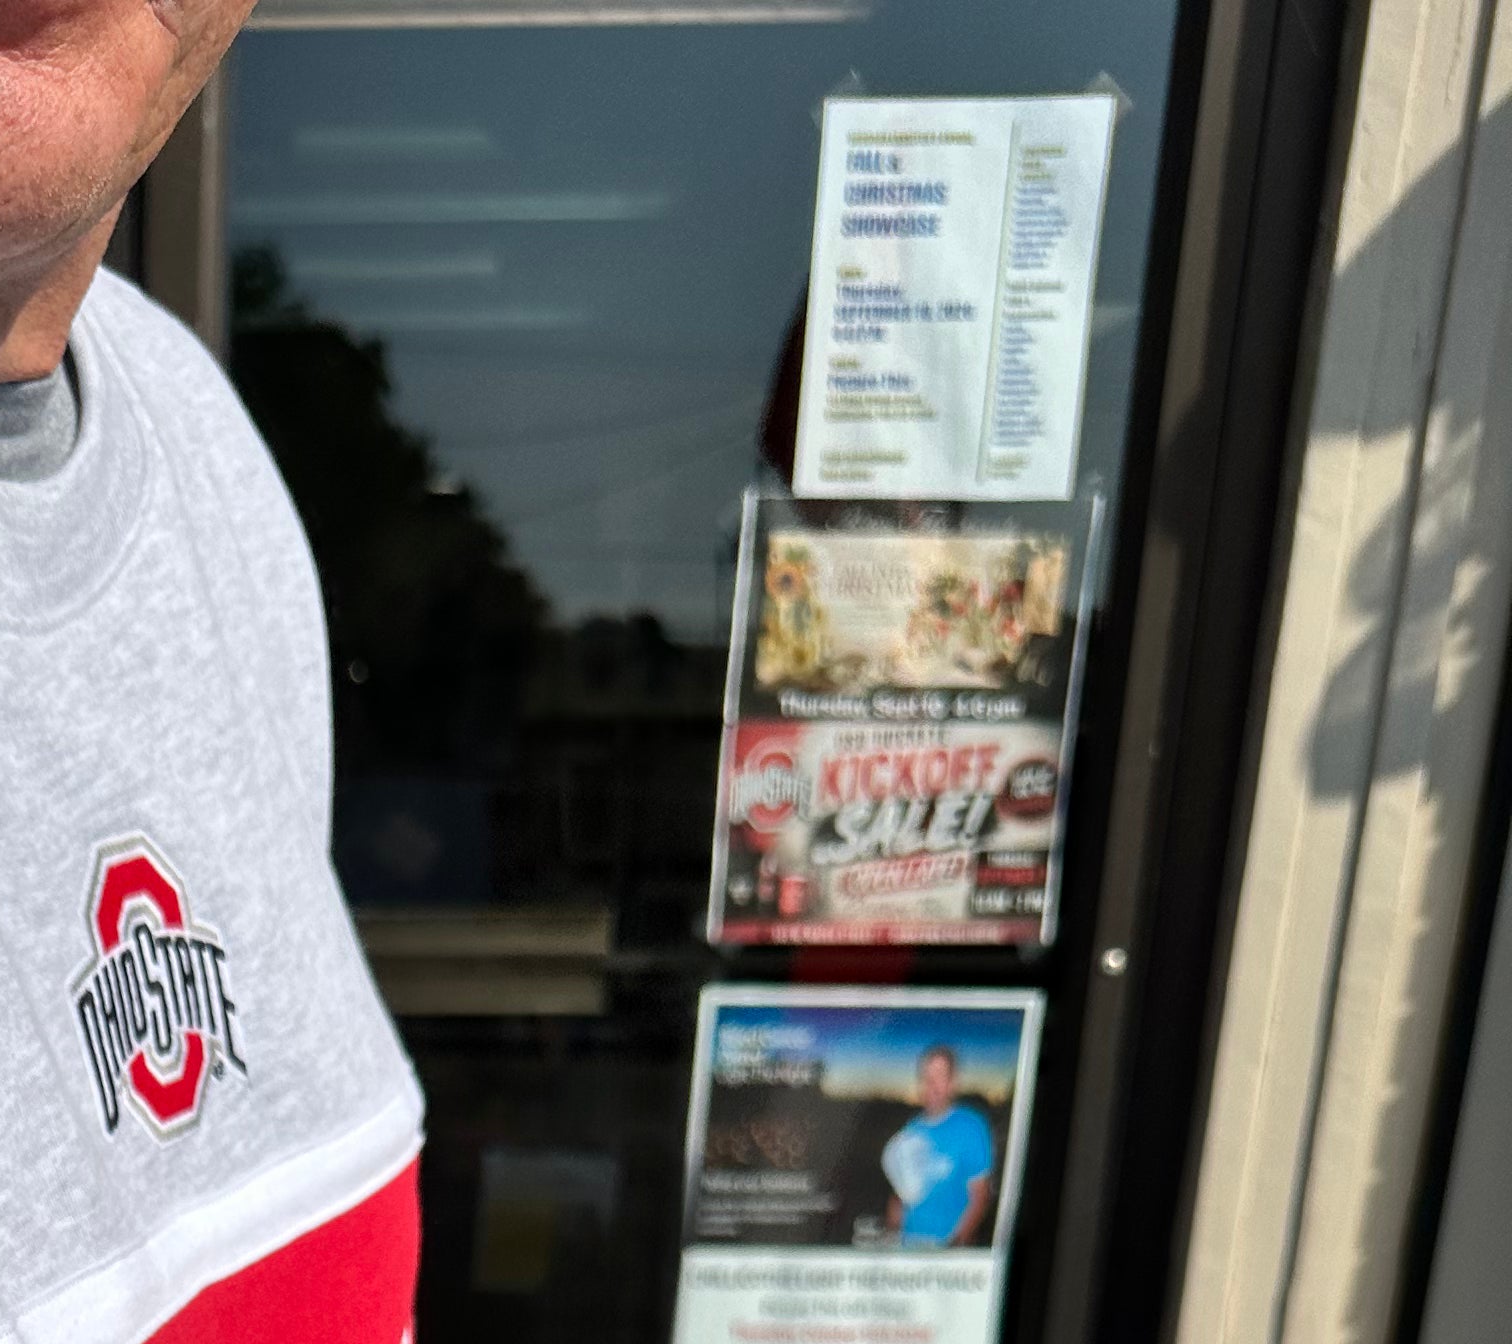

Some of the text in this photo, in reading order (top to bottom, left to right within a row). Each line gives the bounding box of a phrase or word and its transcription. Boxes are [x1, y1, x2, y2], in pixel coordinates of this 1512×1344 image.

[843, 182, 948, 207] CHRISTMAS
[840, 213, 941, 238] SHOWCASE
[817, 741, 1001, 802] KICKOFF
[816, 790, 998, 862] SALE!
